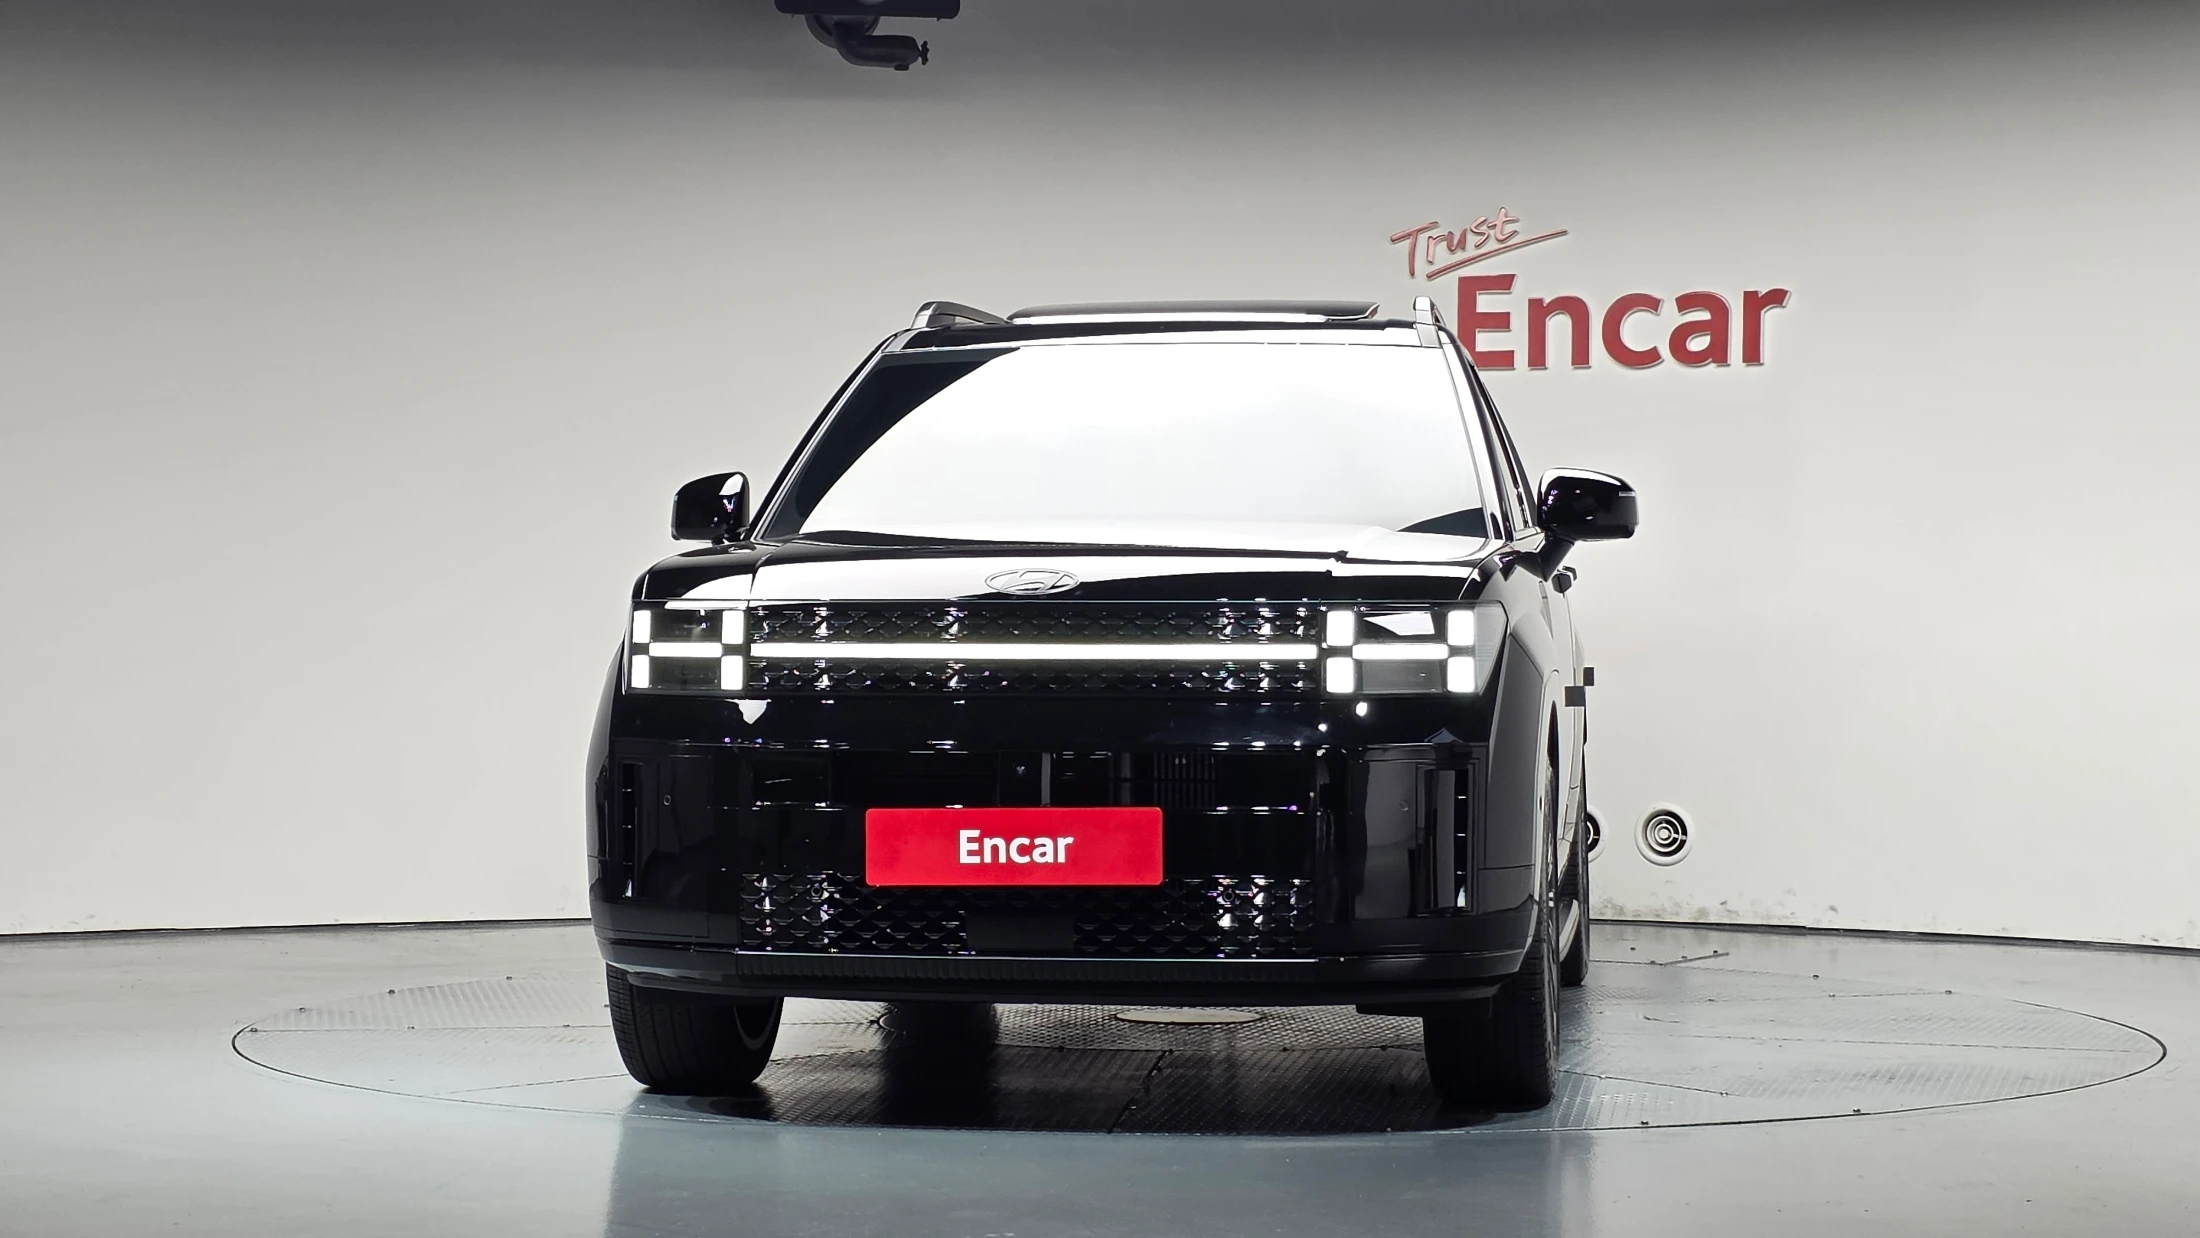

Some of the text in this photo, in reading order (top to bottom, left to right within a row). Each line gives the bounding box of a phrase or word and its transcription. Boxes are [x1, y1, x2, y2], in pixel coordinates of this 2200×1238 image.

[1389, 206, 1520, 279] Trust
[1457, 273, 1791, 370] Encar
[959, 829, 1074, 864] Encar
